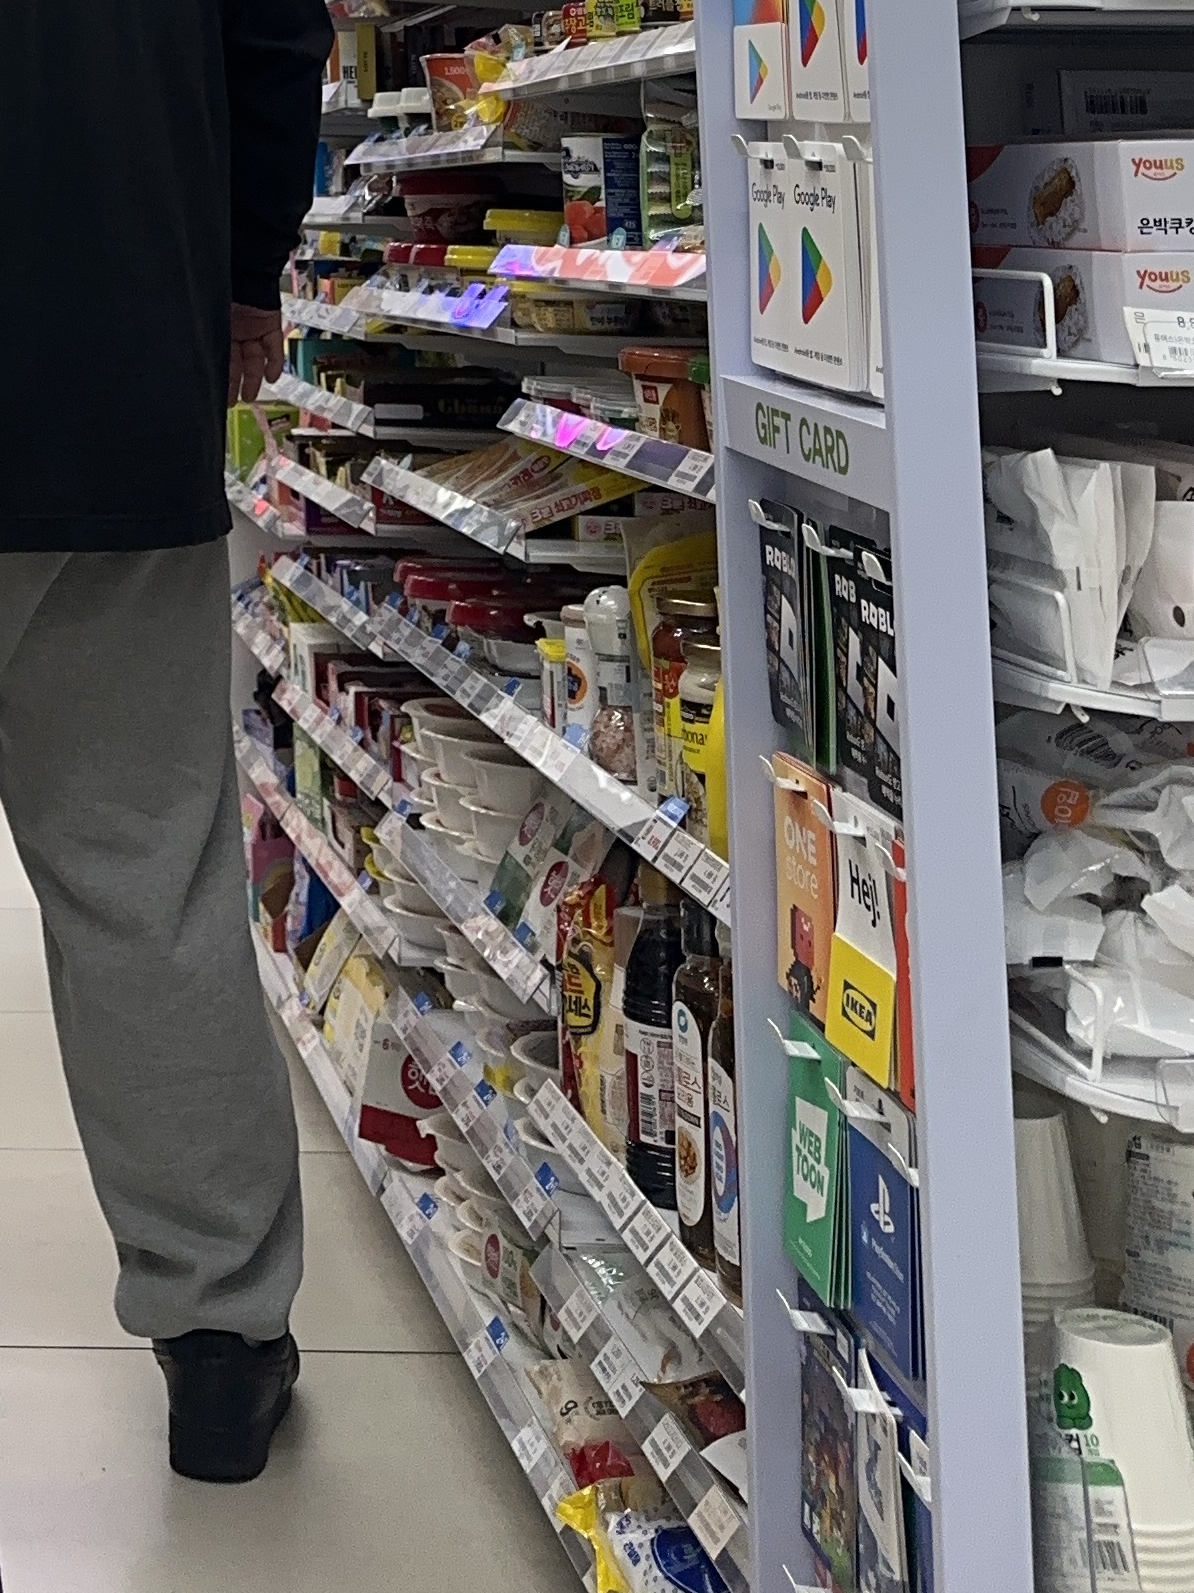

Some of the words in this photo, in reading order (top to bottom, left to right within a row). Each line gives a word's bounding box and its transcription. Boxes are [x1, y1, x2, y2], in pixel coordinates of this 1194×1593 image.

[1131, 157, 1185, 178] youus
[751, 182, 772, 207] Google
[772, 185, 786, 210] Play
[794, 184, 820, 212] Google
[821, 187, 836, 214] Play
[1136, 269, 1191, 290] youus
[755, 401, 792, 455] GIFT
[799, 417, 850, 477] CARD
[783, 814, 817, 866] ONE
[785, 850, 819, 901] store
[848, 858, 881, 928] Hej!
[845, 993, 876, 1031] IKEA
[798, 1120, 823, 1166] WEB
[794, 1145, 828, 1199] TOON
